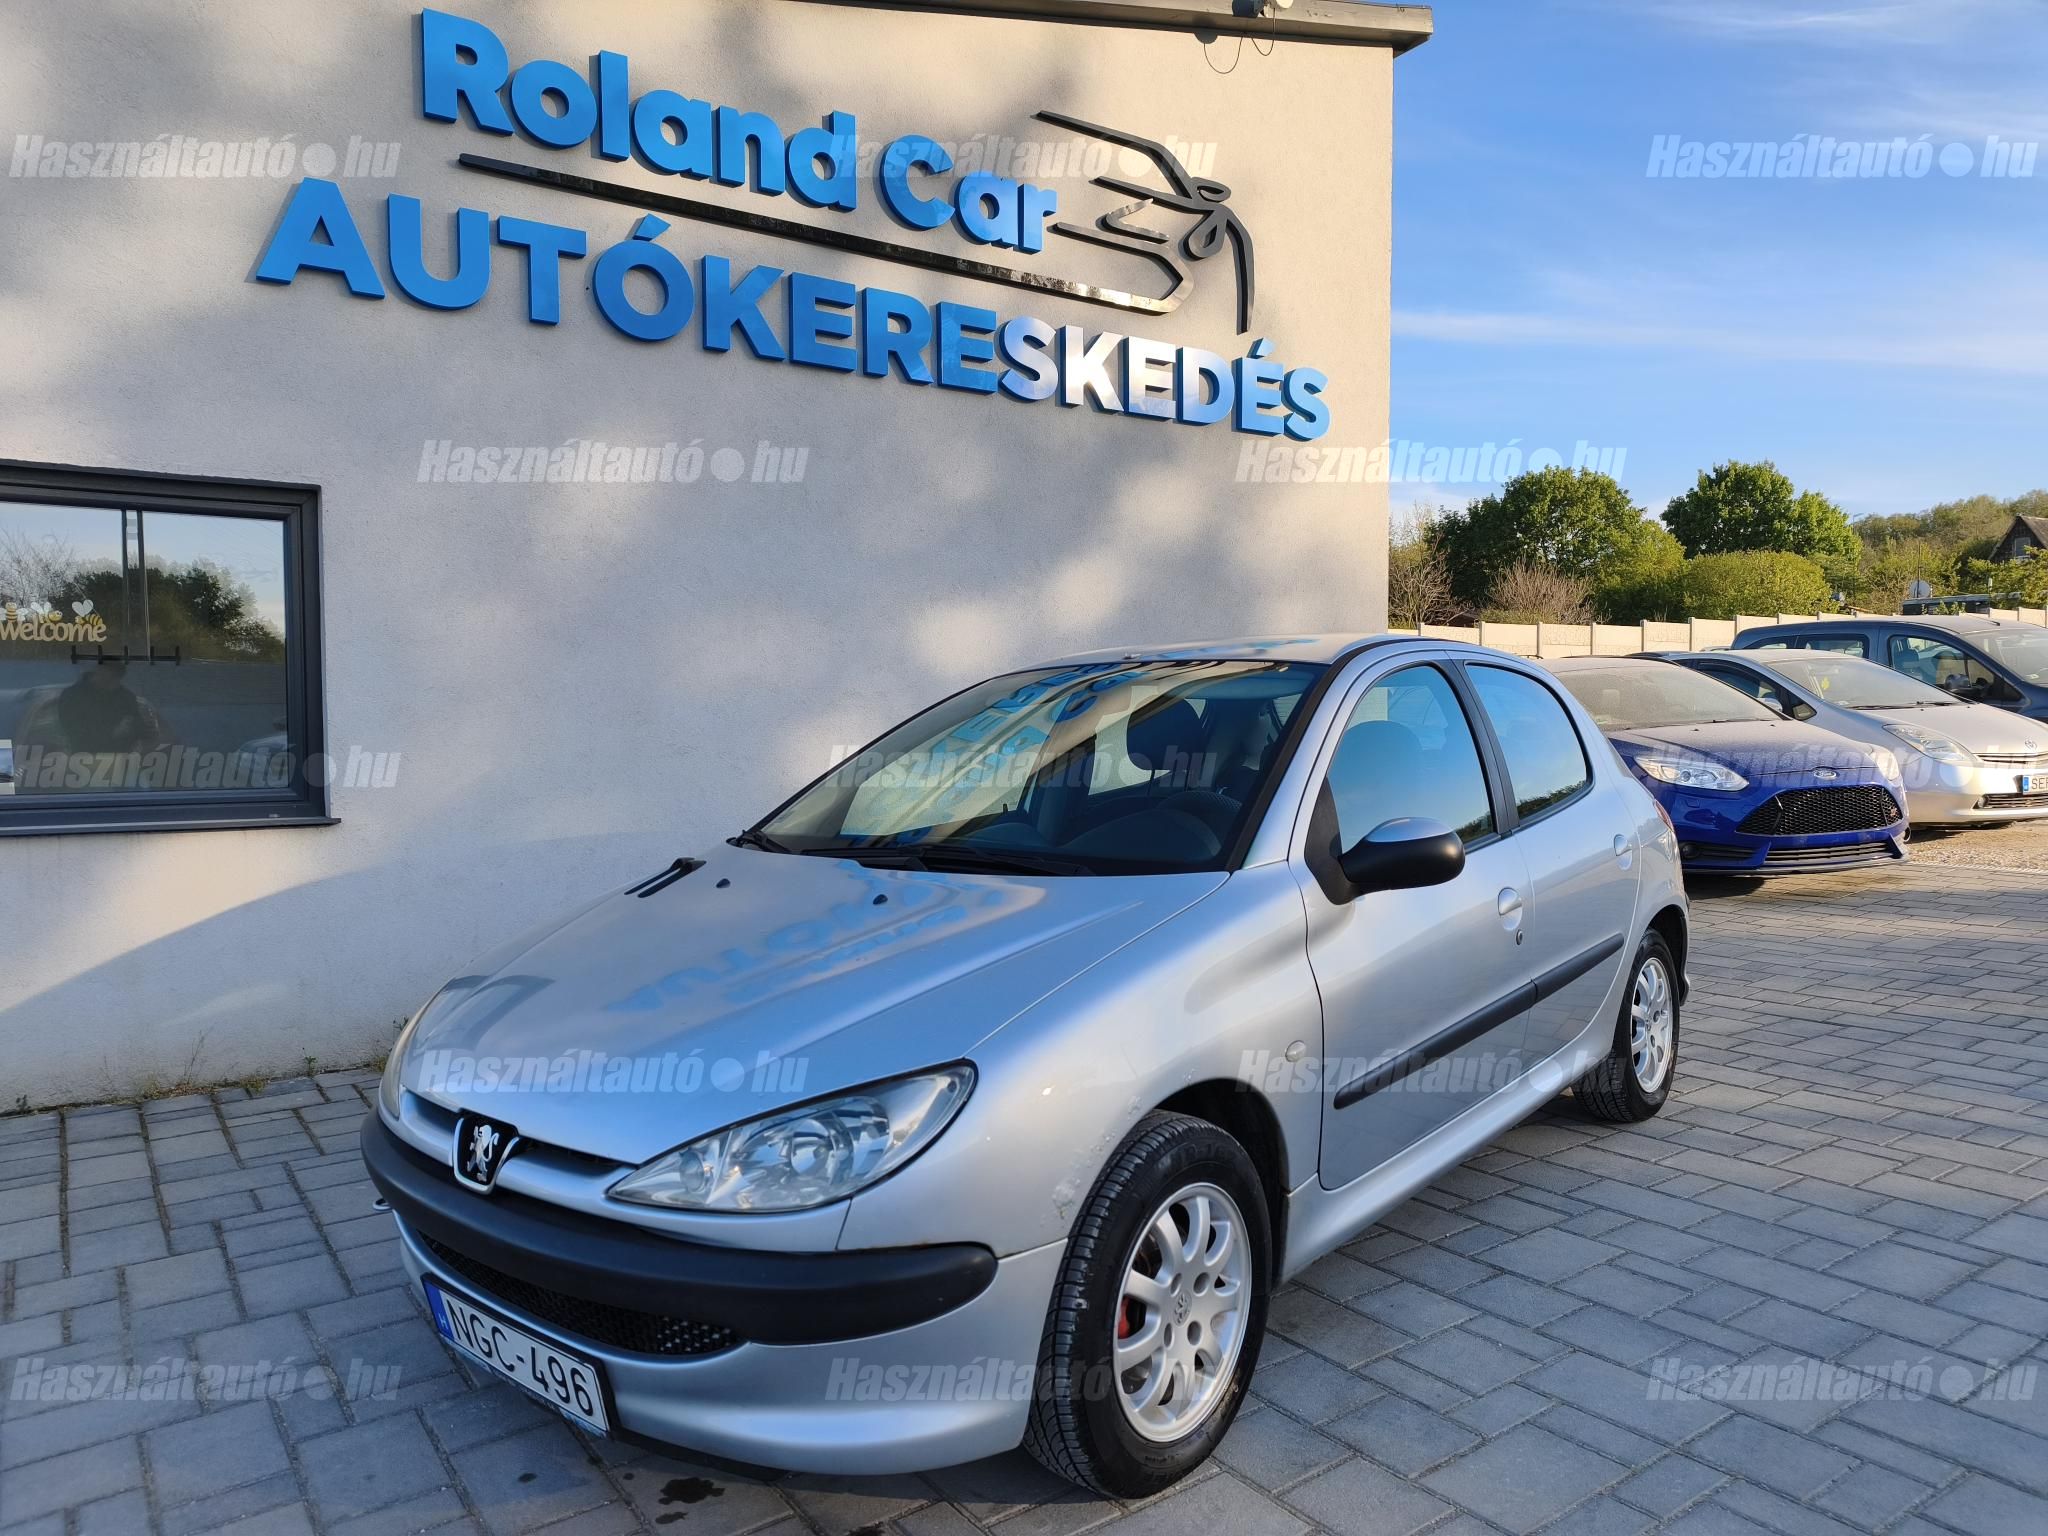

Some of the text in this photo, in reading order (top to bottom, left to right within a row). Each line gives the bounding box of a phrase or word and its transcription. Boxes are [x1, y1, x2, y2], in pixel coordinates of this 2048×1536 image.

[420, 7, 1058, 253] Roland Car
[256, 177, 1330, 441] AUTÓKERESKEDÉS
[446, 1299, 594, 1417] NGC-496
